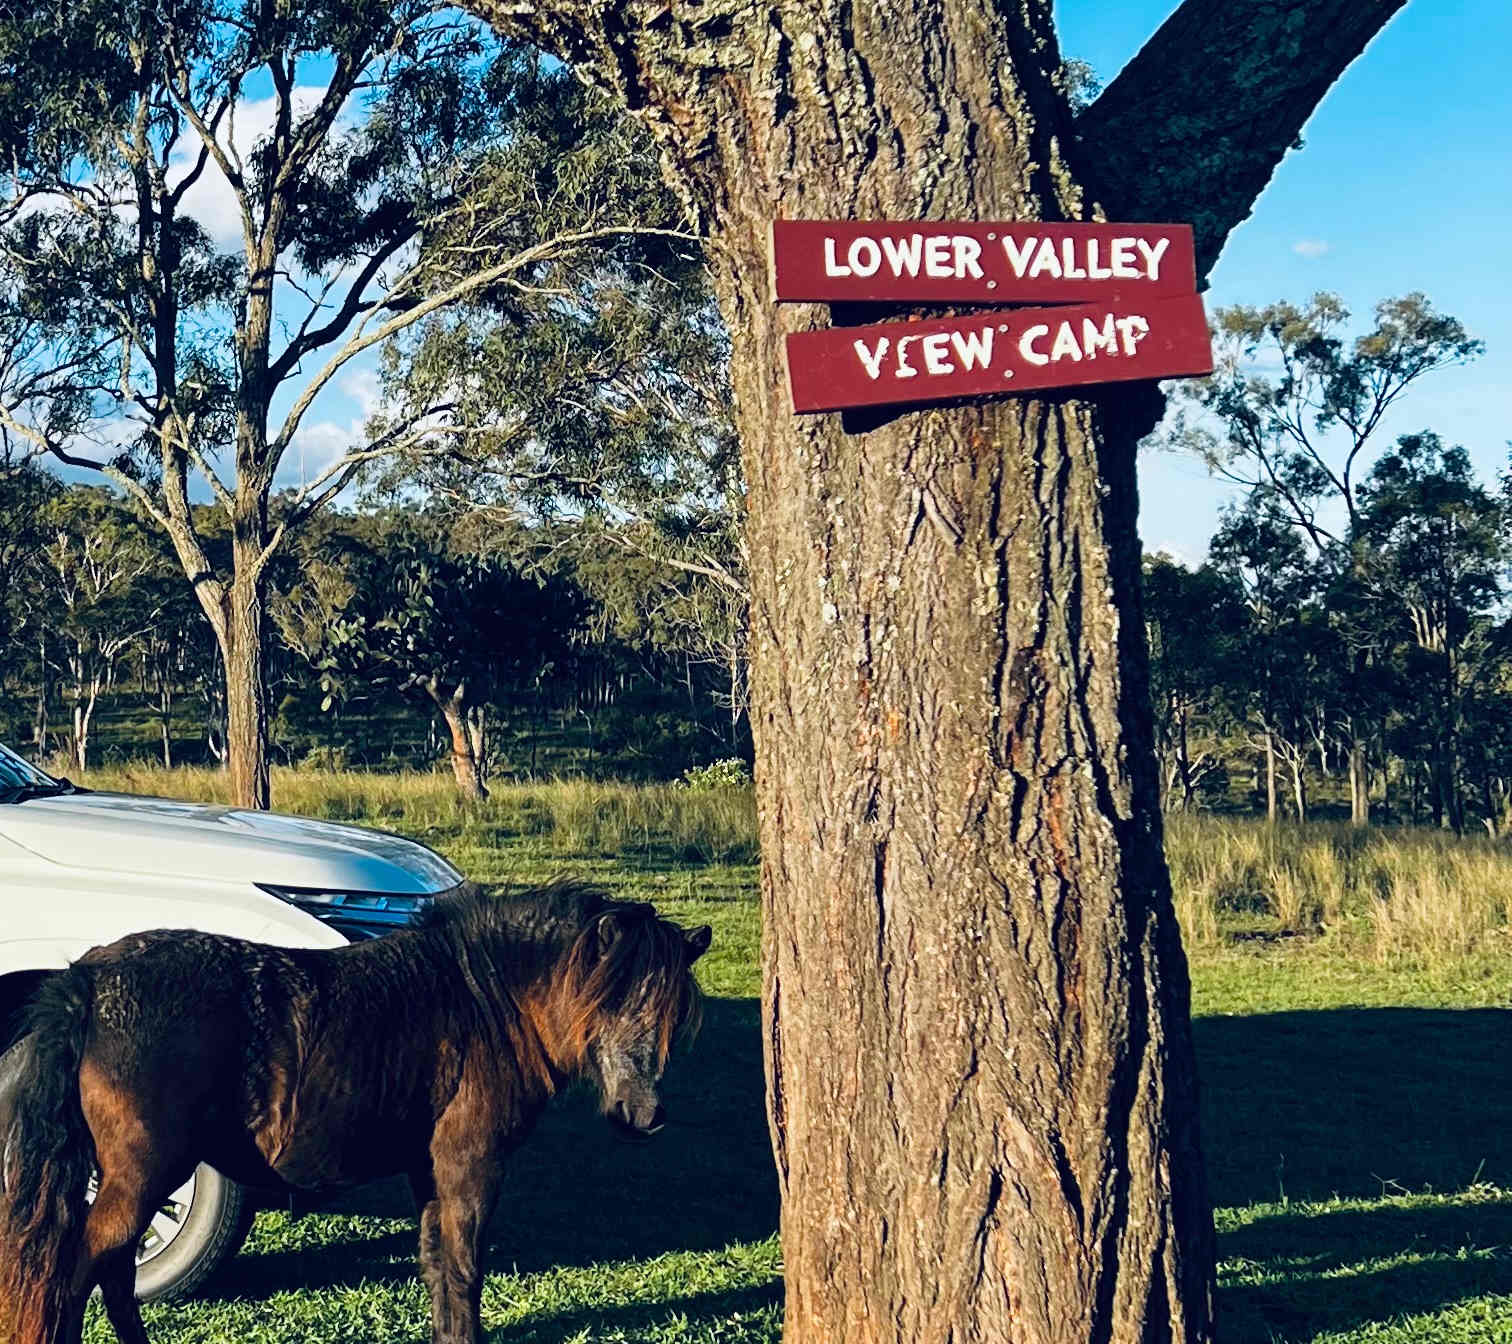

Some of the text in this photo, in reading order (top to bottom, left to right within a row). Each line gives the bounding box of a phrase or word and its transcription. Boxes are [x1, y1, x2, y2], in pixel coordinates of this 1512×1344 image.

[824, 233, 1170, 282] LOWER VALLEY
[853, 313, 1150, 380] VIEW CAMP
